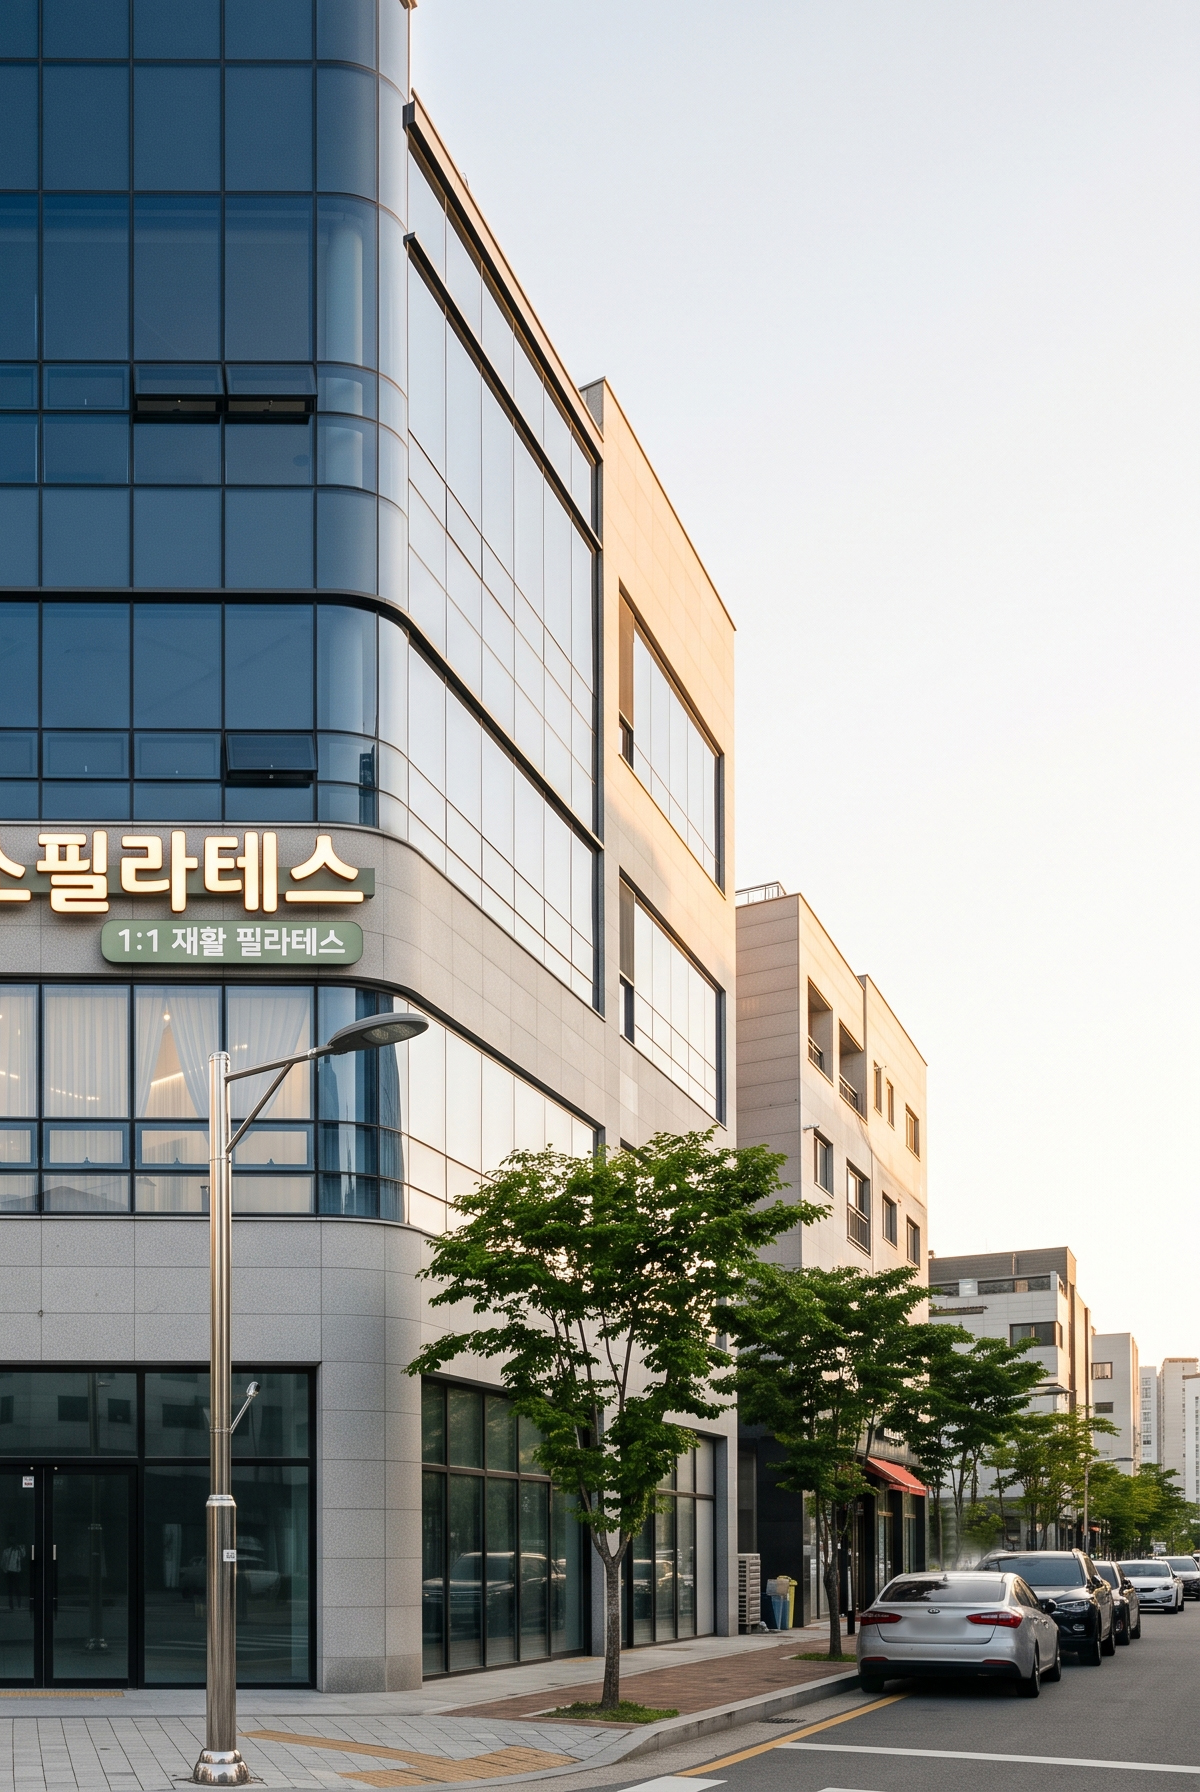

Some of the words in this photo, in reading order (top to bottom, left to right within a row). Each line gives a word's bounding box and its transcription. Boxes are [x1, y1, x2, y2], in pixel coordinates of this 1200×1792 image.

[118, 927, 159, 953] 1:1
[171, 926, 227, 956] 재활
[236, 927, 346, 957] 필라테스
